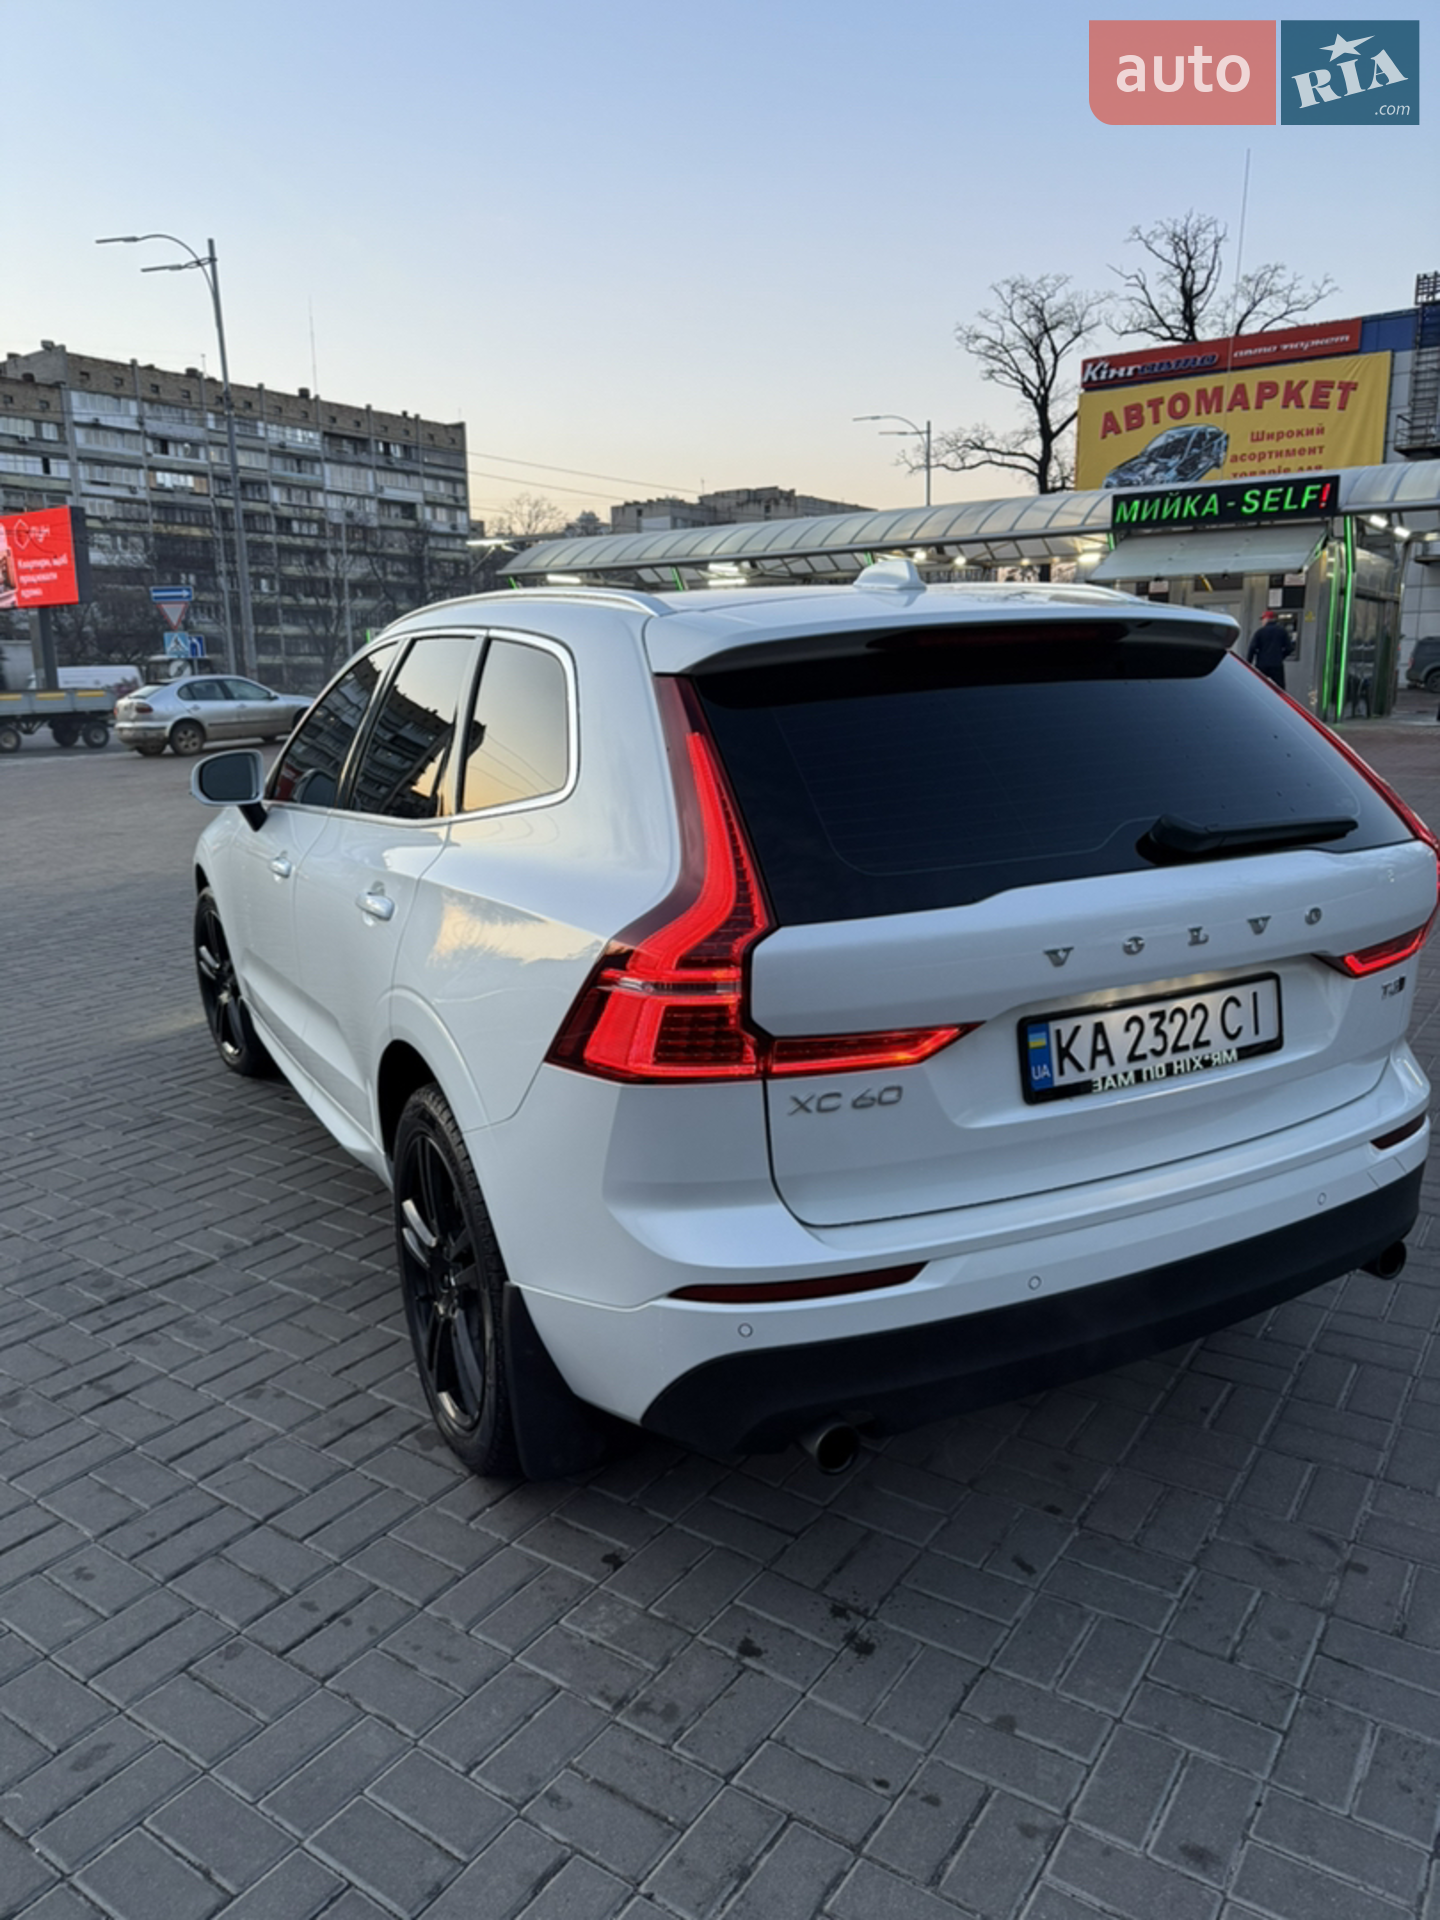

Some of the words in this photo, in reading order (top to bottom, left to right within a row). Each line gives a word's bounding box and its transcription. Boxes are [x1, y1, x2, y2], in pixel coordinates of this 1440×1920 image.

[1100, 379, 1358, 439] АВТОМАРКЕТ
[1250, 423, 1325, 443] Широкий
[1229, 445, 1324, 463] асортимент
[1115, 492, 1219, 524] МИЙКА
[1241, 483, 1332, 515] SELF!
[1043, 907, 1323, 967] VOLVO
[1055, 1021, 1115, 1077] KA
[1124, 1002, 1211, 1063] 2322
[1031, 1064, 1051, 1080] UA
[1092, 1070, 1135, 1093] ЗАМ
[1142, 1062, 1166, 1081] ПО
